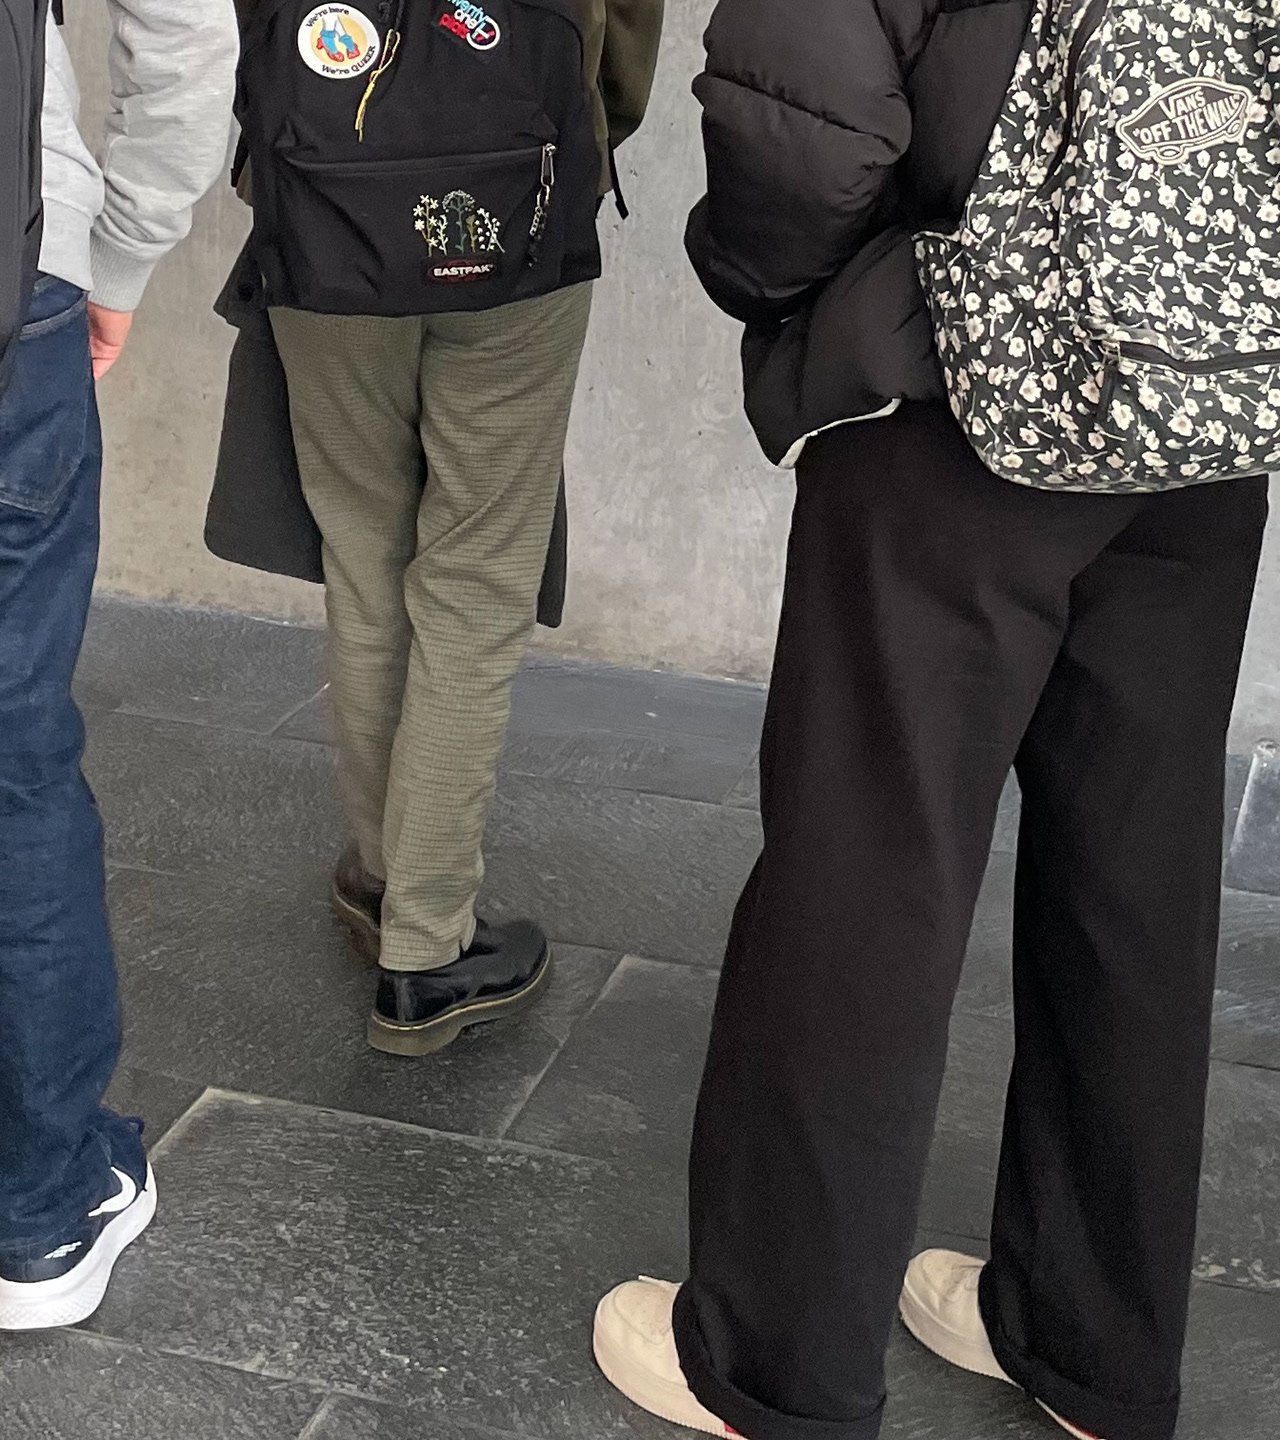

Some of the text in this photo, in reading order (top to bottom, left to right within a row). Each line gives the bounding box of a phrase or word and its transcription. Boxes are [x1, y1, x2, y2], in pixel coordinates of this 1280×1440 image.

[328, 6, 350, 15] here
[454, 9, 478, 30] one
[322, 45, 376, 75] We're QUEER
[1158, 86, 1206, 120] VANS
[1171, 107, 1208, 139] THE
[433, 264, 490, 277] EASTPAK
